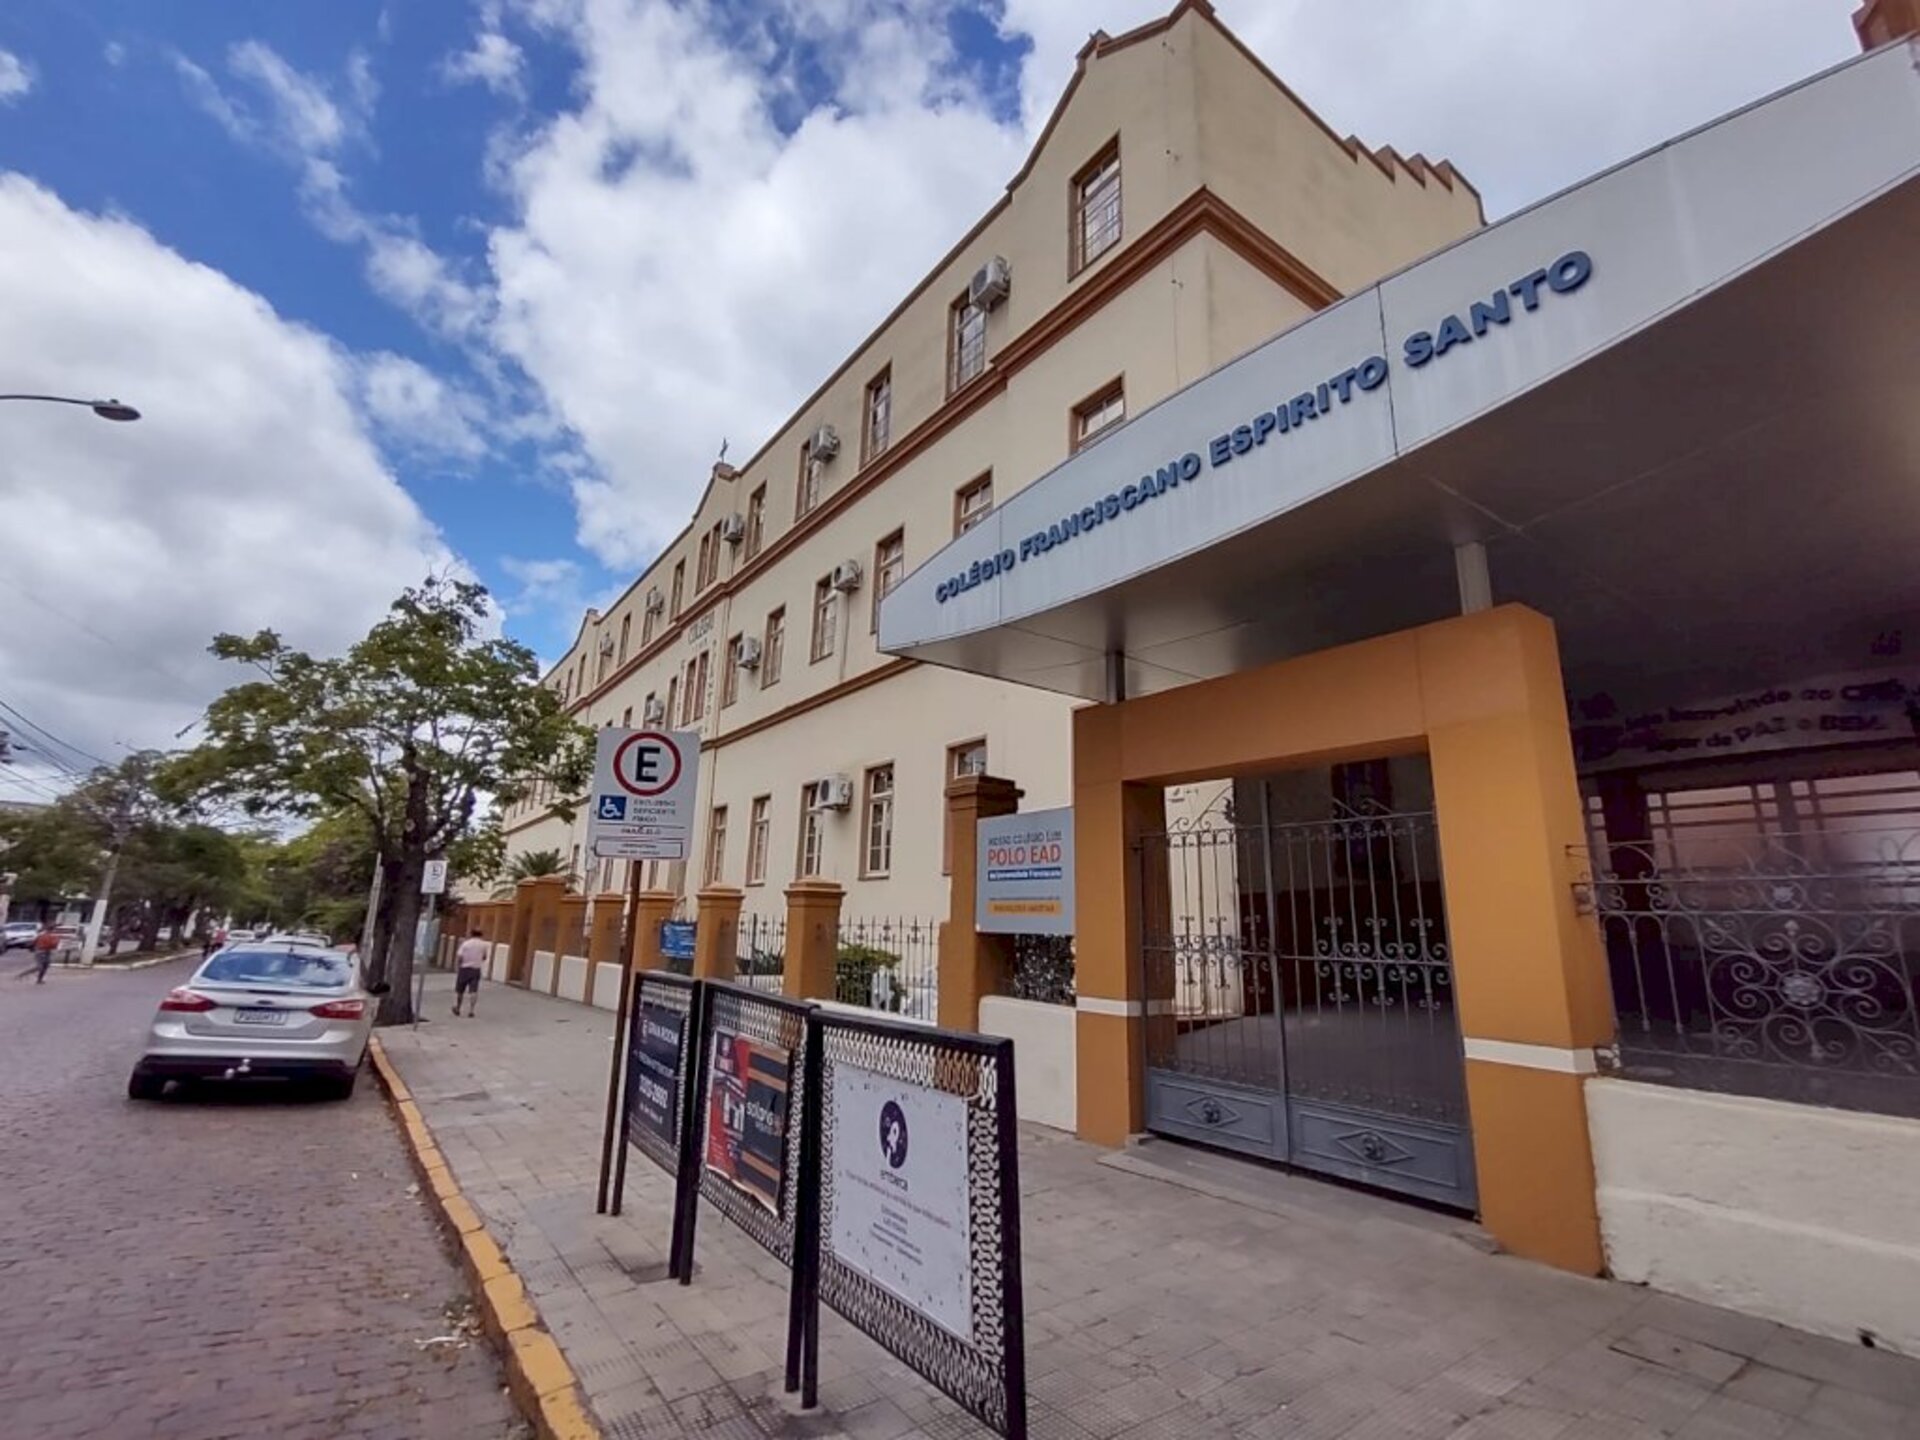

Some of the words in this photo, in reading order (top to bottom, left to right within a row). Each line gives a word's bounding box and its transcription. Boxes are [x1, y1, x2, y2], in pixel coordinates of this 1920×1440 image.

[935, 547, 1014, 603] COLÉGIO
[1019, 452, 1202, 562] FRANCISCANO
[1208, 355, 1390, 467] ESPIRITO
[1403, 249, 1593, 367] SANTO
[635, 746, 661, 783] E
[988, 847, 1026, 866] POLO
[1030, 844, 1061, 864] EAD
